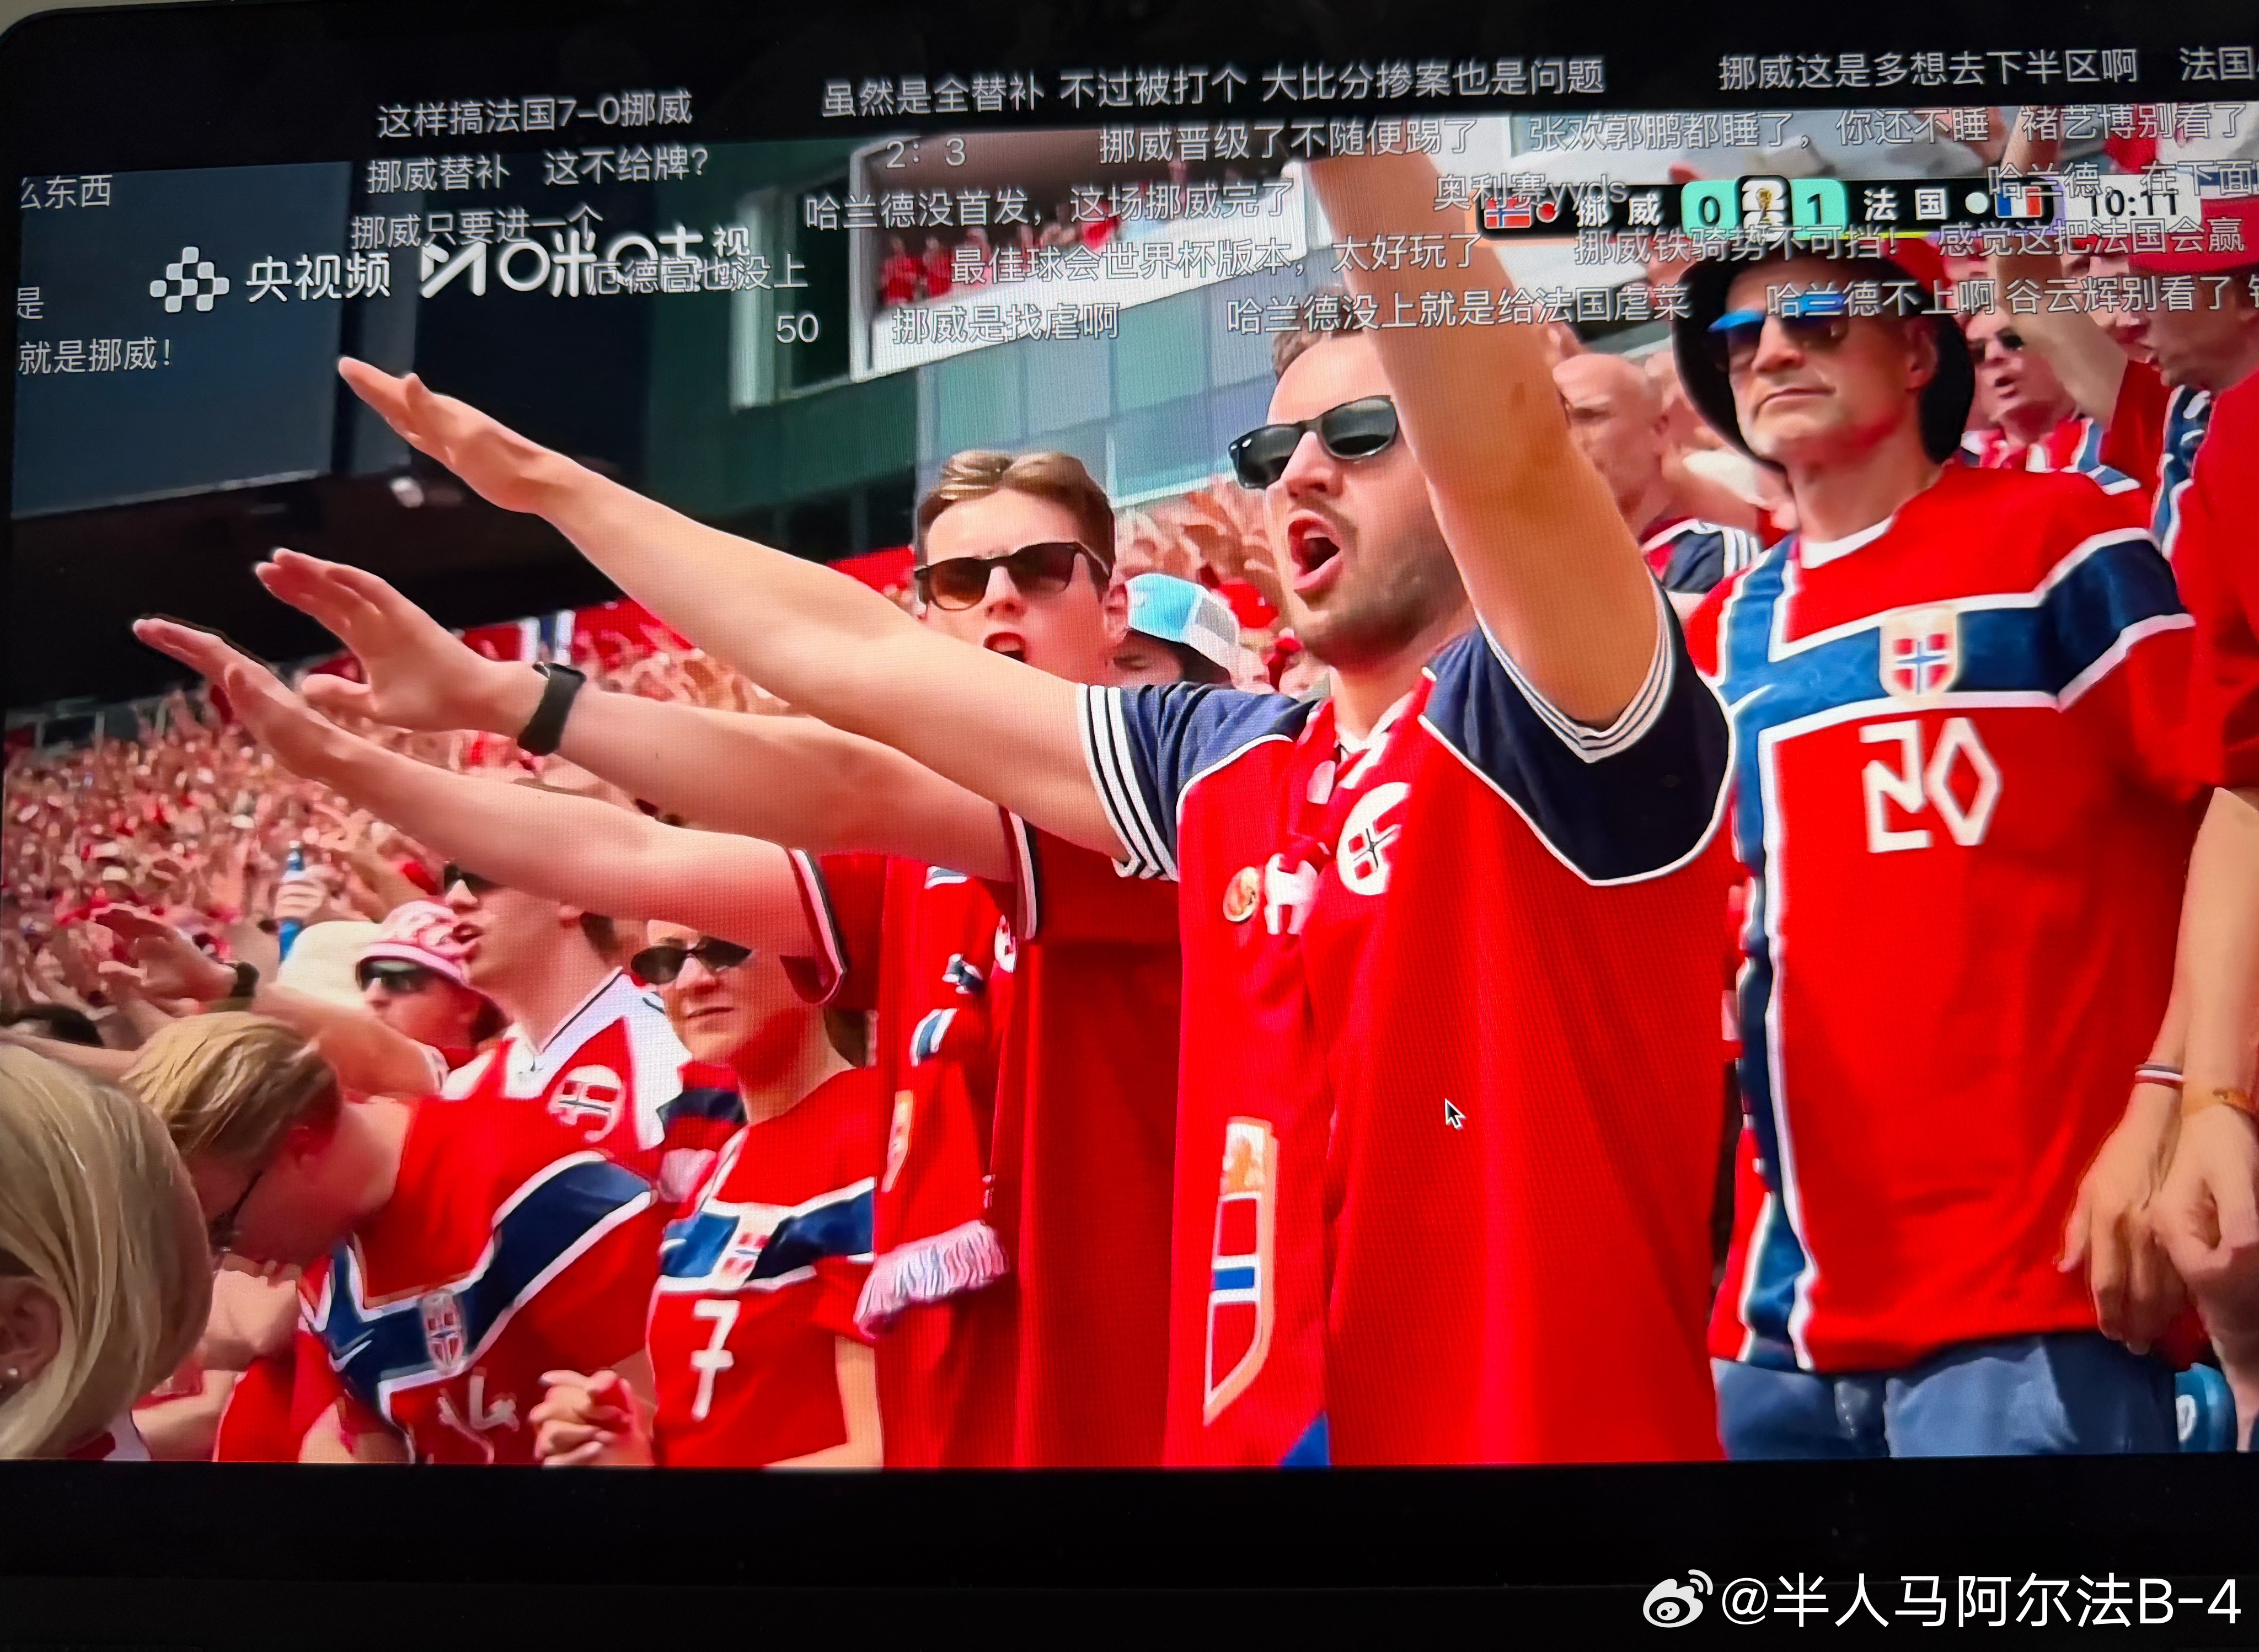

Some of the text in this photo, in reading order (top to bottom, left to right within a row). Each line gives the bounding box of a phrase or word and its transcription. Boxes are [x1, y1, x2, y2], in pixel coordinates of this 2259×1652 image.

[1719, 48, 2138, 92] 挪威这是多想去下半区啊
[2179, 46, 2259, 81] 法国
[822, 58, 1605, 117] 虽然是全替补 不过被打个 大比分掺案也是问题
[377, 89, 693, 139] 这样搞法国7-0挪威
[1099, 118, 1478, 164] 挪威晋级了不随便踢了
[21, 174, 113, 210] 么东西
[367, 154, 511, 194] 挪威替补
[1698, 195, 1721, 227] 0
[1807, 193, 1823, 225] 1
[1864, 188, 1949, 222] 法国
[351, 204, 604, 250] 挪威只要进一个
[1938, 217, 2245, 257] 感觉这把法国会赢
[247, 251, 390, 302] 央视频
[2005, 275, 2231, 313] 谷云辉别看了
[1227, 282, 1692, 335] 哈兰德没上就是给法国虐菜
[1766, 278, 1995, 319] 哈兰德不上啊
[775, 314, 820, 344] 50
[892, 303, 1120, 344] 挪威是找虐啊
[1859, 717, 2003, 853] 20
[691, 1300, 740, 1421] 7
